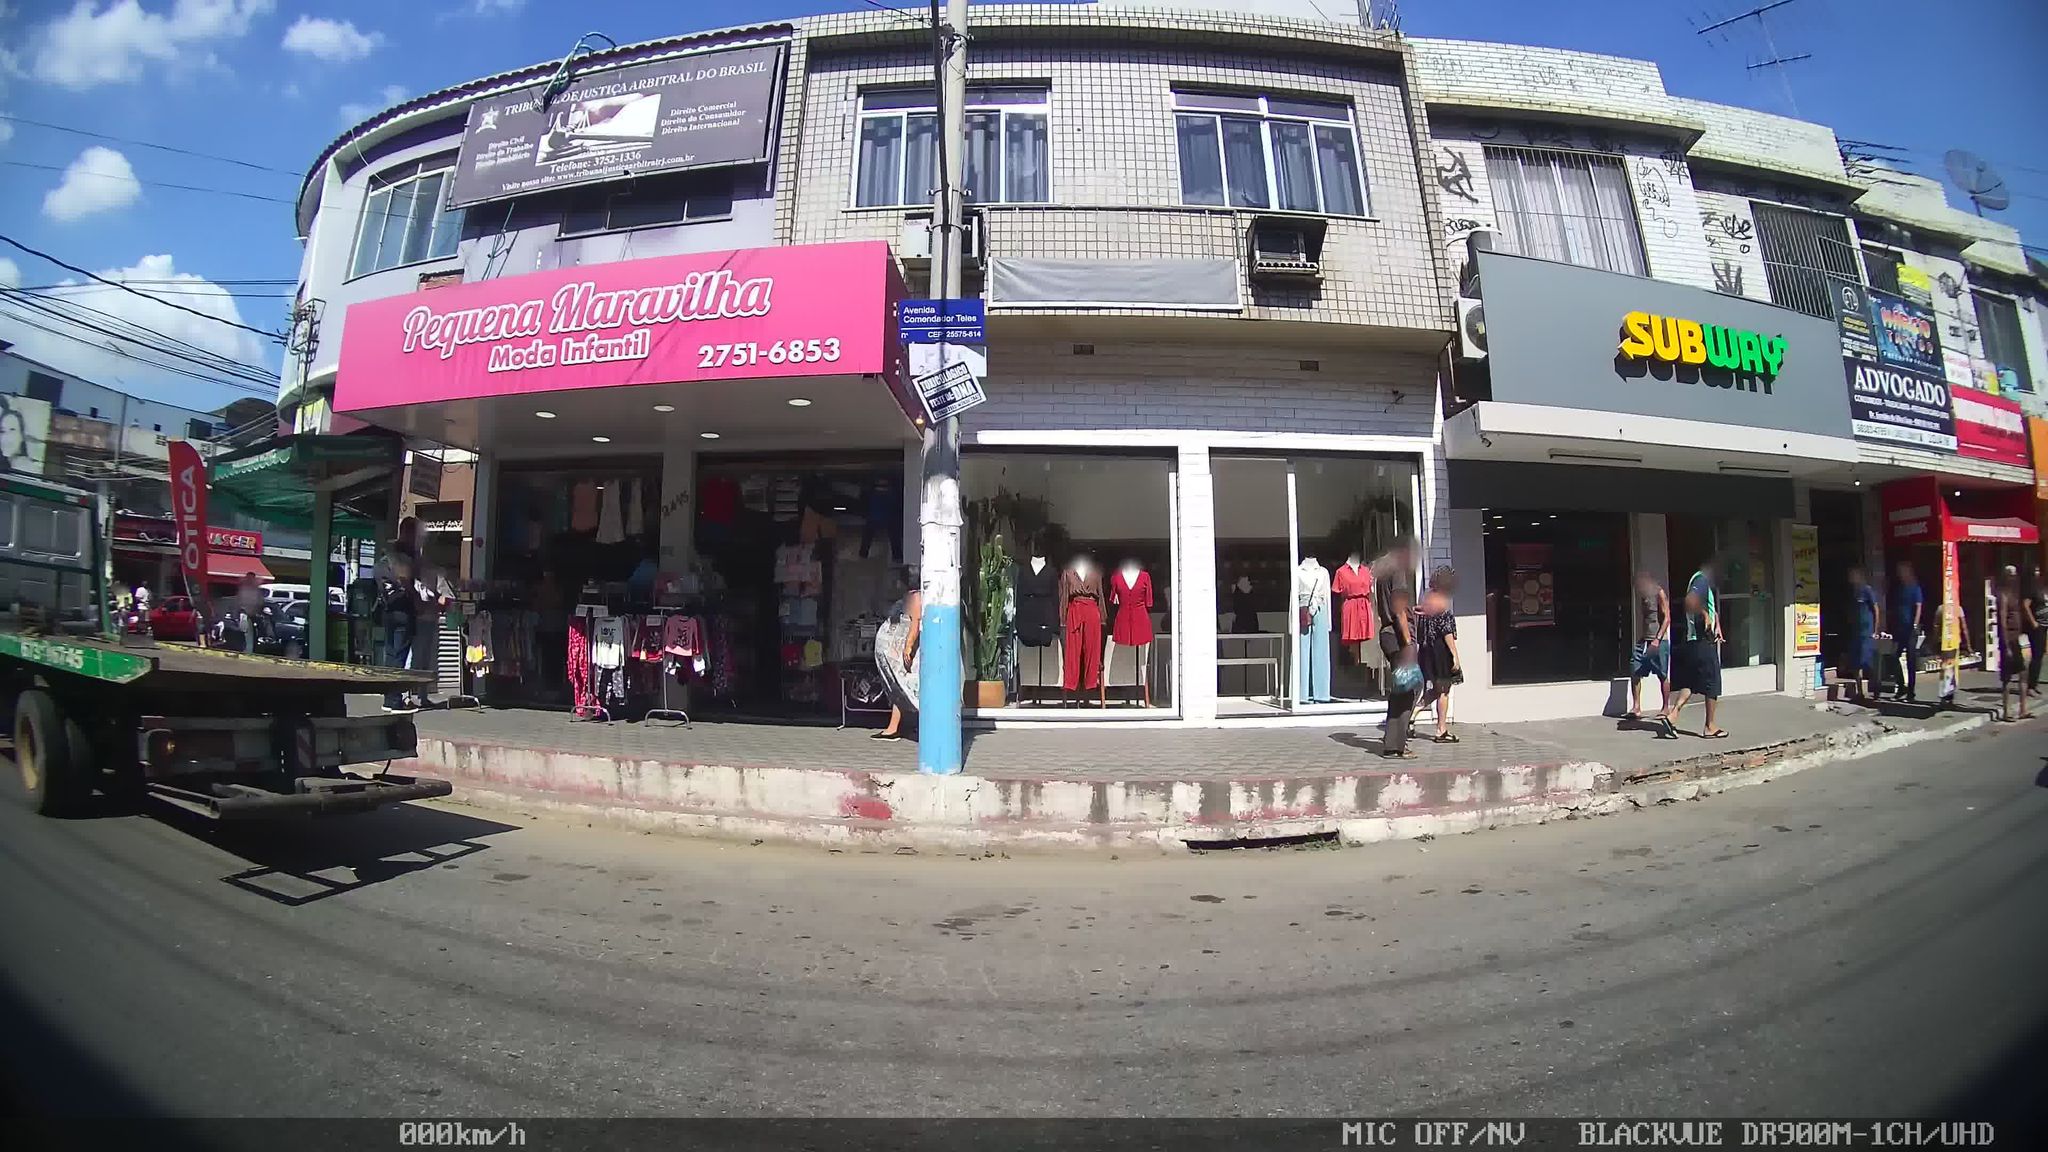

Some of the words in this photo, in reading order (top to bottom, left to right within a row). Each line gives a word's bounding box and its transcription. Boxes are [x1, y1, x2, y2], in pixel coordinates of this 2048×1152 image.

[504, 94, 560, 116] TRIBUNL
[562, 90, 579, 103] DE
[578, 82, 627, 100] JUSTIÇA
[628, 72, 693, 91] ARBITRAL
[696, 68, 717, 81] DO
[719, 61, 767, 77] BRASIL
[661, 117, 686, 127] Direito
[698, 109, 747, 121] Consumidor
[670, 106, 696, 117] Direito
[698, 101, 737, 113] Comercial
[661, 125, 687, 135] Direito
[689, 118, 740, 131] Internacional
[550, 159, 591, 174] Telefone:
[593, 150, 642, 168] 3752-1336
[402, 299, 544, 360] Pequena
[551, 269, 774, 337] Maravilha
[903, 306, 935, 315] Avenida
[903, 314, 955, 324] Comendador
[956, 314, 977, 323] Teles
[487, 340, 556, 373] Moda
[561, 327, 651, 365] Infantil
[698, 336, 842, 369] 2751-6853
[1616, 310, 1790, 377] SUBWAY
[950, 379, 978, 401] DNA
[1854, 364, 1947, 408] ADVOGADO
[180, 464, 203, 571] OTICA
